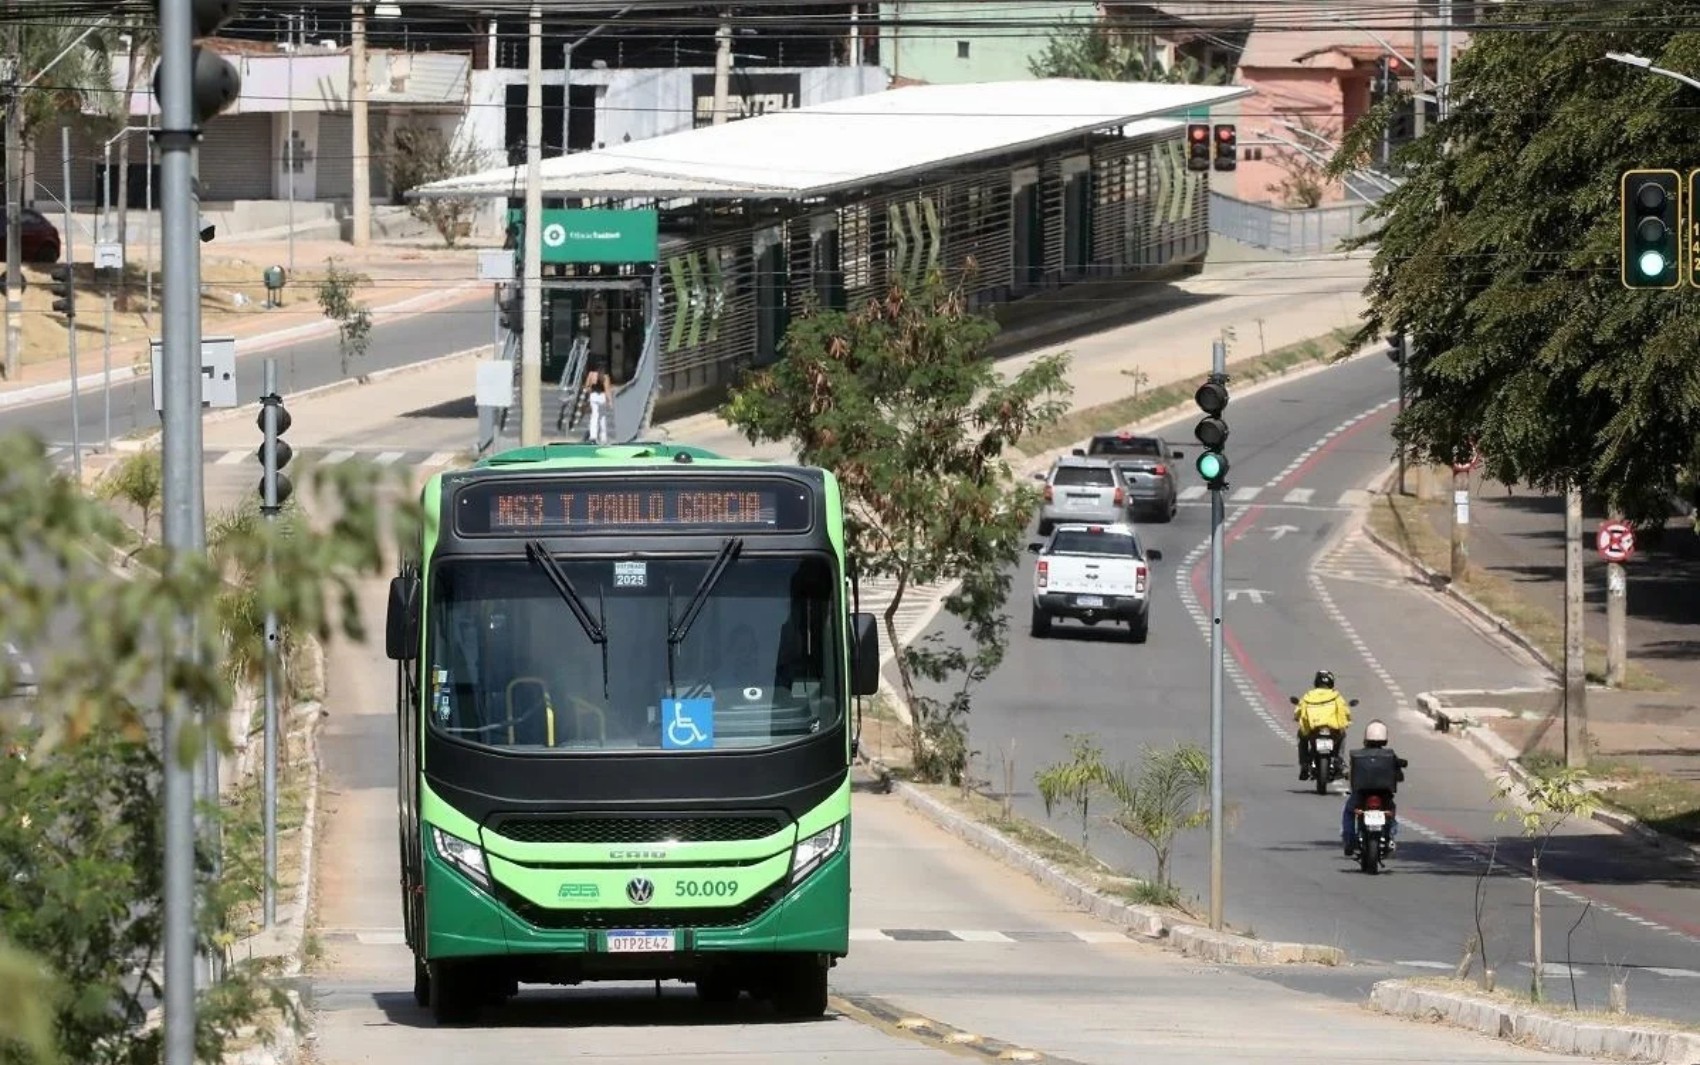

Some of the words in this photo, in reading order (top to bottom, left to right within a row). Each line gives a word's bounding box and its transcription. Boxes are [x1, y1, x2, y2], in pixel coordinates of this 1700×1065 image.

[560, 493, 574, 525] T
[588, 493, 664, 524] PAULO
[678, 491, 760, 522] GARCIA
[616, 574, 644, 585] 2025
[675, 880, 739, 896] 50.009
